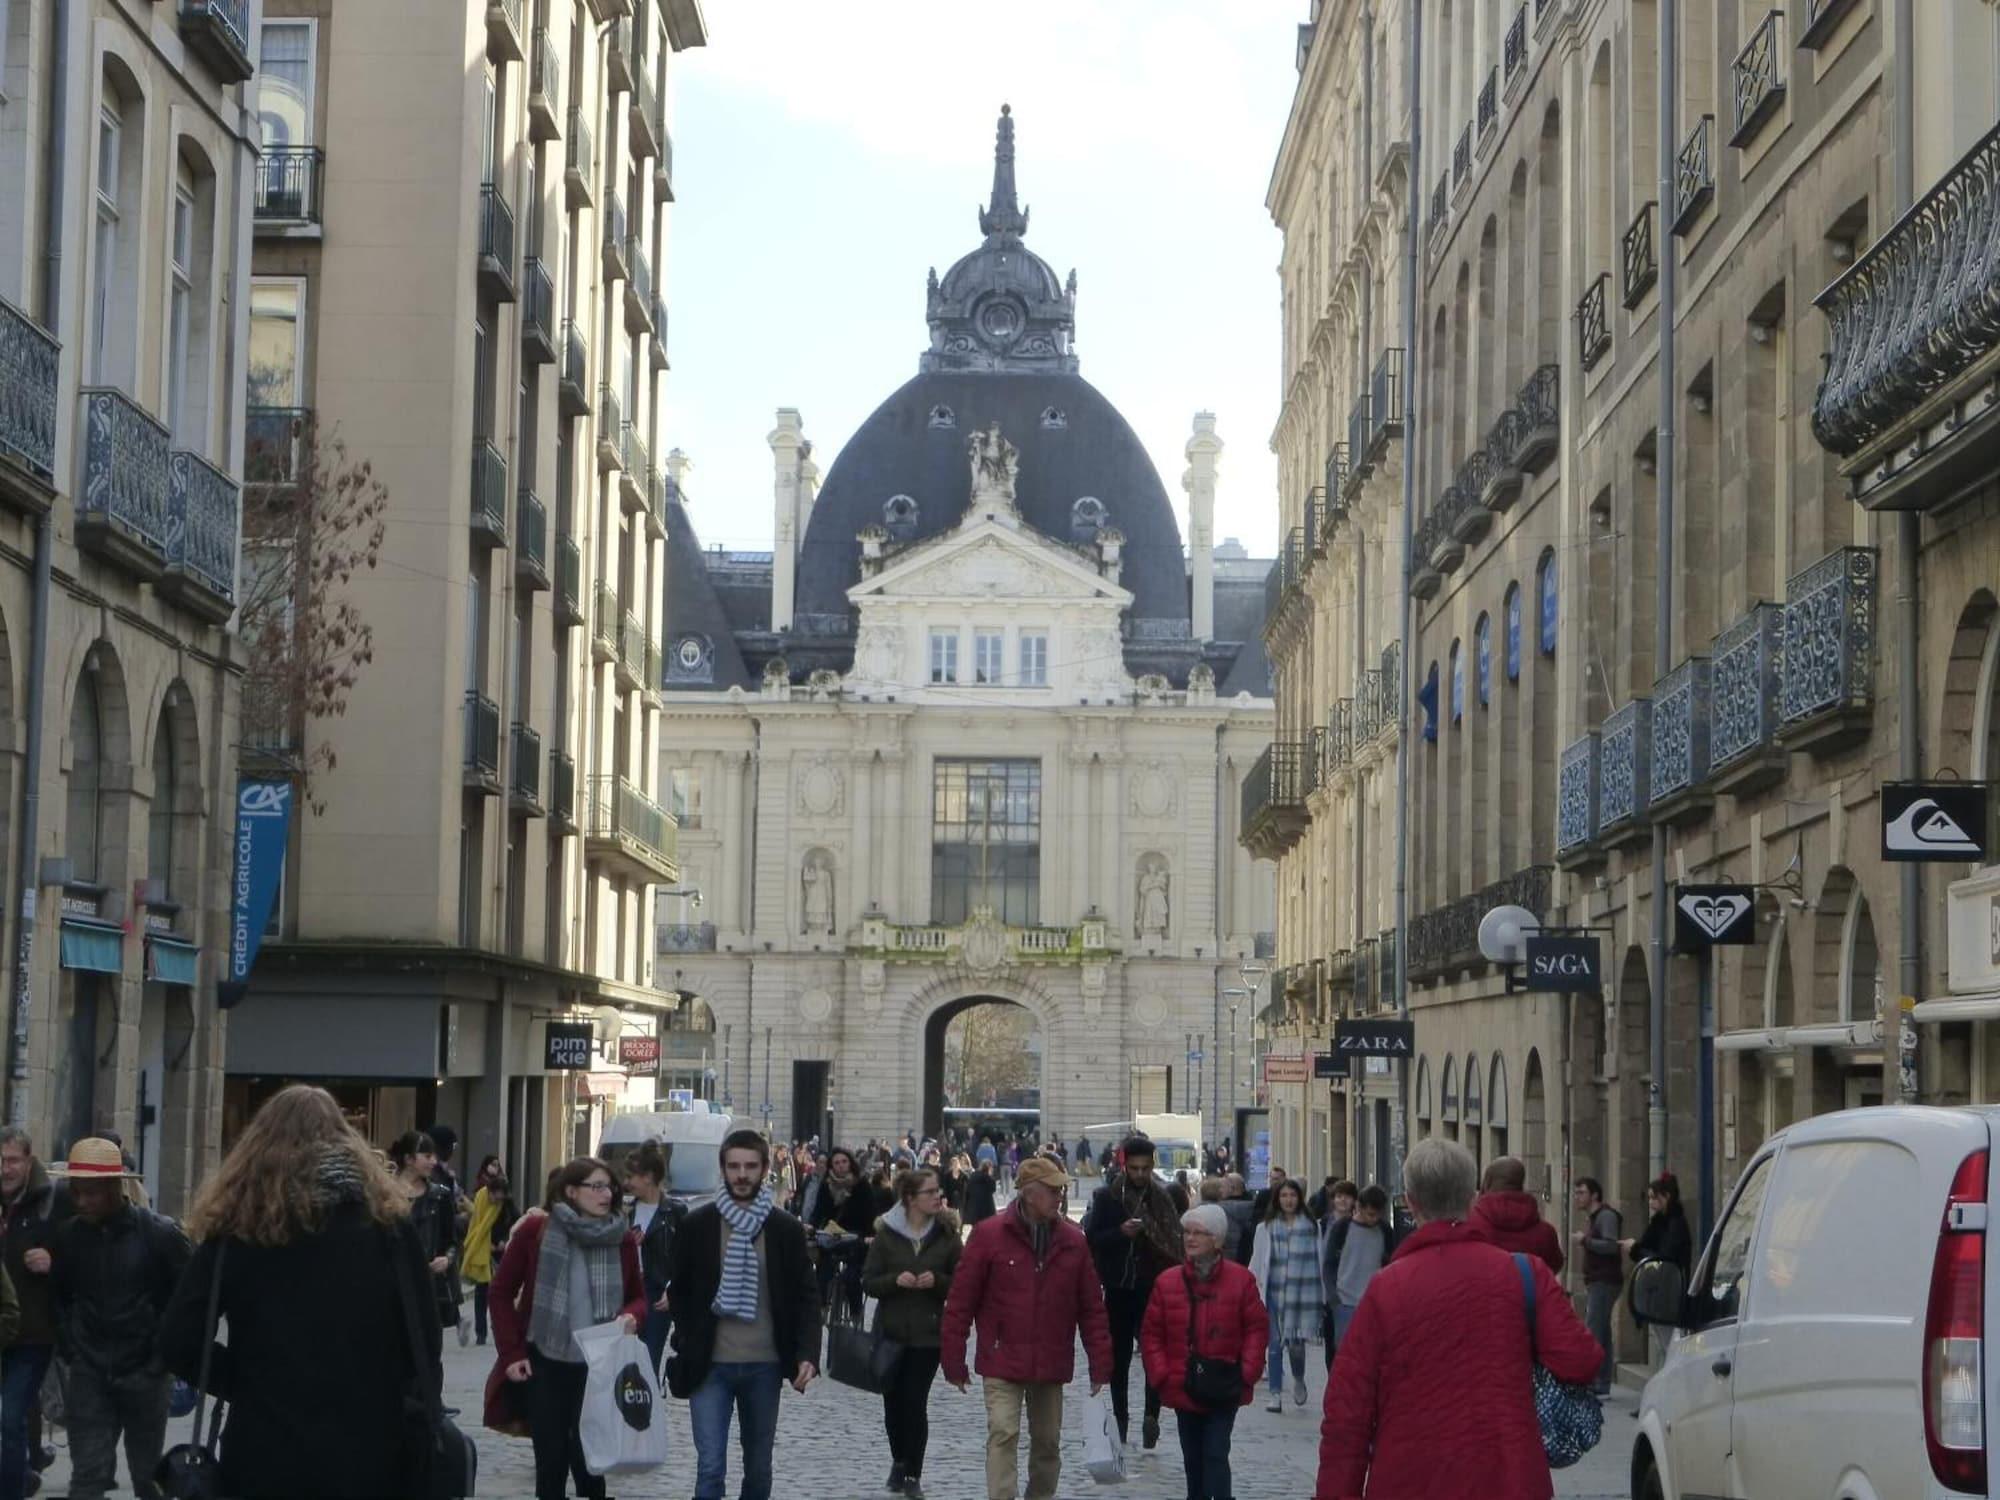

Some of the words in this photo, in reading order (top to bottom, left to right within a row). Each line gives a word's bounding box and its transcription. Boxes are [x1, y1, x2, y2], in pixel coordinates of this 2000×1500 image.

[237, 819, 253, 908] AGRICOLE
[234, 912, 248, 976] CRÉDIT
[1535, 953, 1591, 975] SAGA
[1339, 1036, 1408, 1050] ZARA
